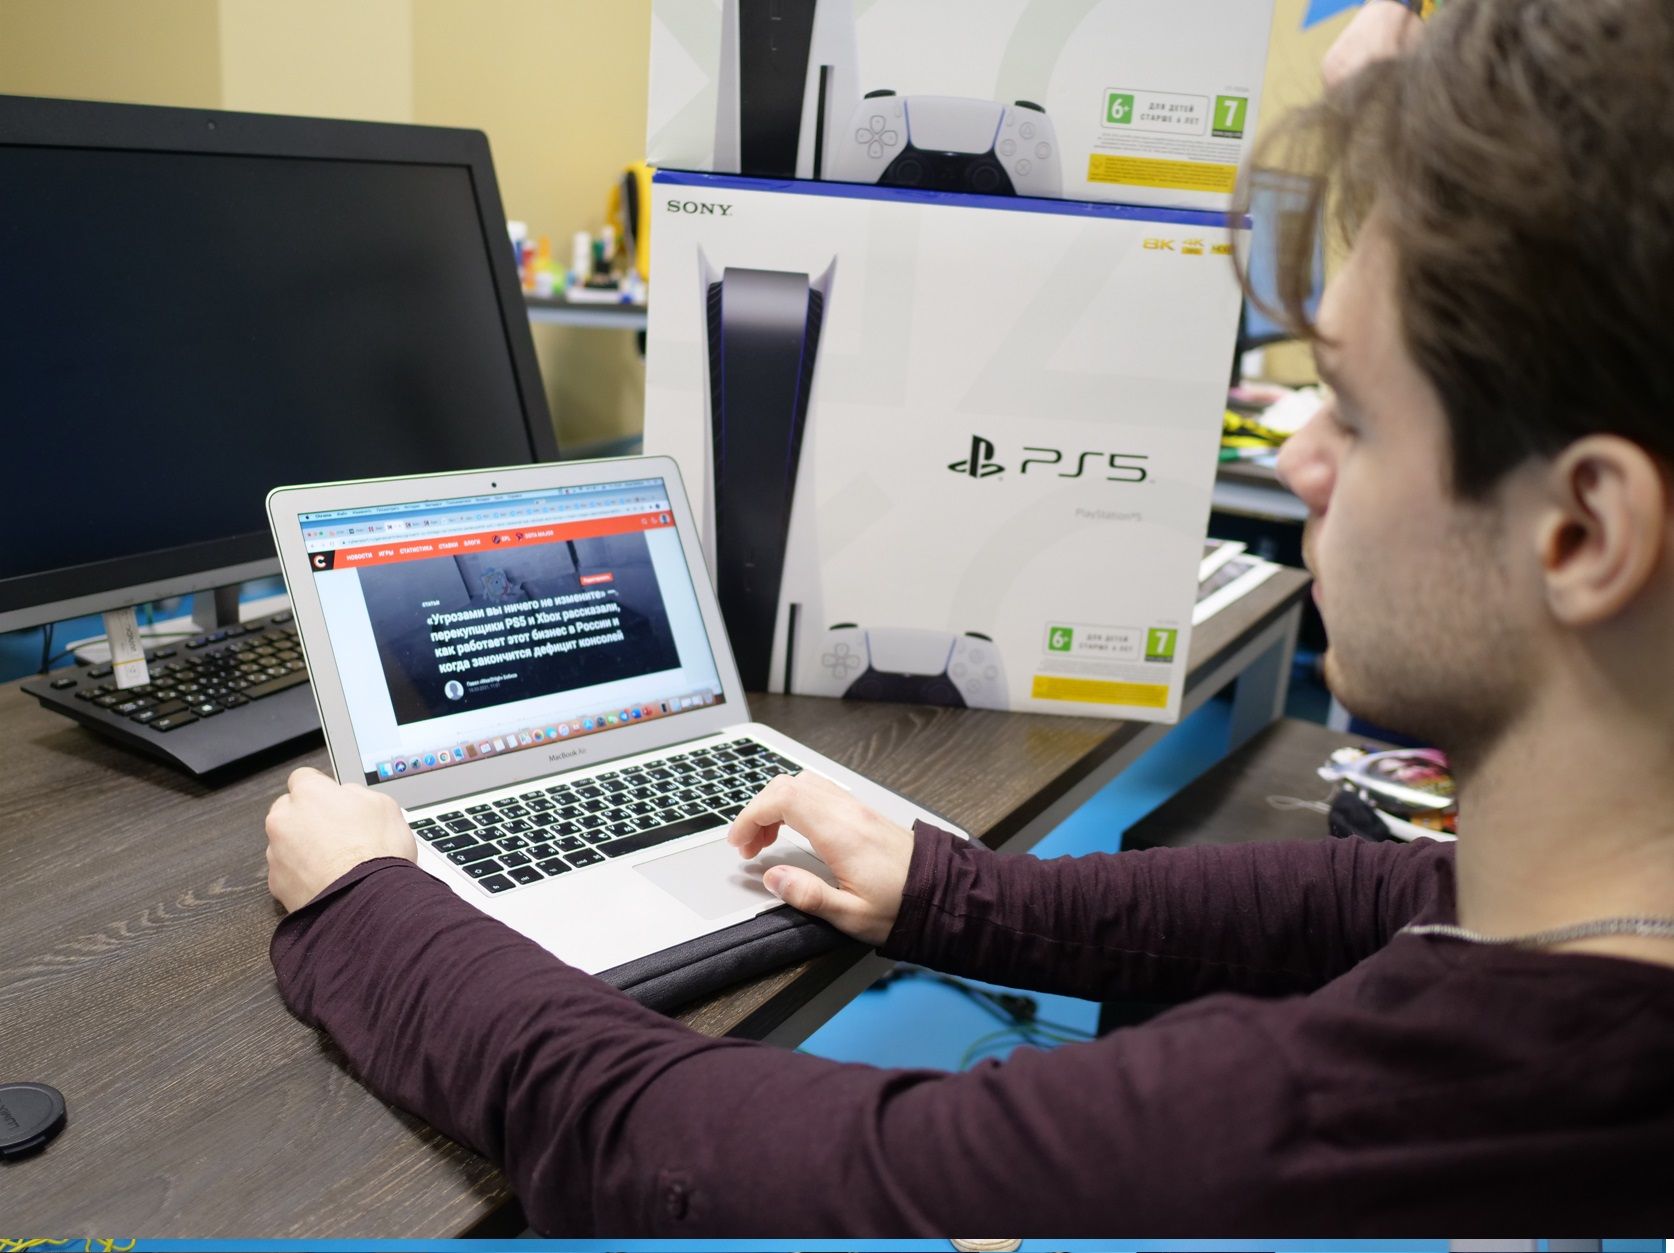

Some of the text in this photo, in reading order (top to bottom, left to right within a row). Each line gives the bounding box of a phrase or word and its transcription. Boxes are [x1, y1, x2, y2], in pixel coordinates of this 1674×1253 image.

[1139, 113, 1173, 123] СТАРШЕ
[1183, 117, 1200, 126] ЛЕТ
[1148, 102, 1195, 114] ДЛЯ ДЕТЕЙ
[1223, 99, 1239, 127] 7
[666, 199, 734, 217] SONY
[1142, 238, 1175, 252] 8K
[1019, 446, 1149, 483] PS5
[346, 538, 481, 561] НОВОСТИ ИГРЫ СТАТИСТИКА СТАВКИ БЛОГИ
[426, 609, 485, 626] «Угрозами
[485, 607, 503, 617] вы
[503, 600, 540, 615] ничего
[540, 599, 554, 608] не
[554, 591, 606, 606] измените»
[430, 602, 621, 642] перекупщики PS5 и Xbox рассказали,
[434, 616, 620, 658] как работает этот бизнес в России и
[1155, 631, 1169, 653] 7
[438, 630, 625, 674] когда закончится дефицит консолей
[548, 750, 577, 762] MacBook
